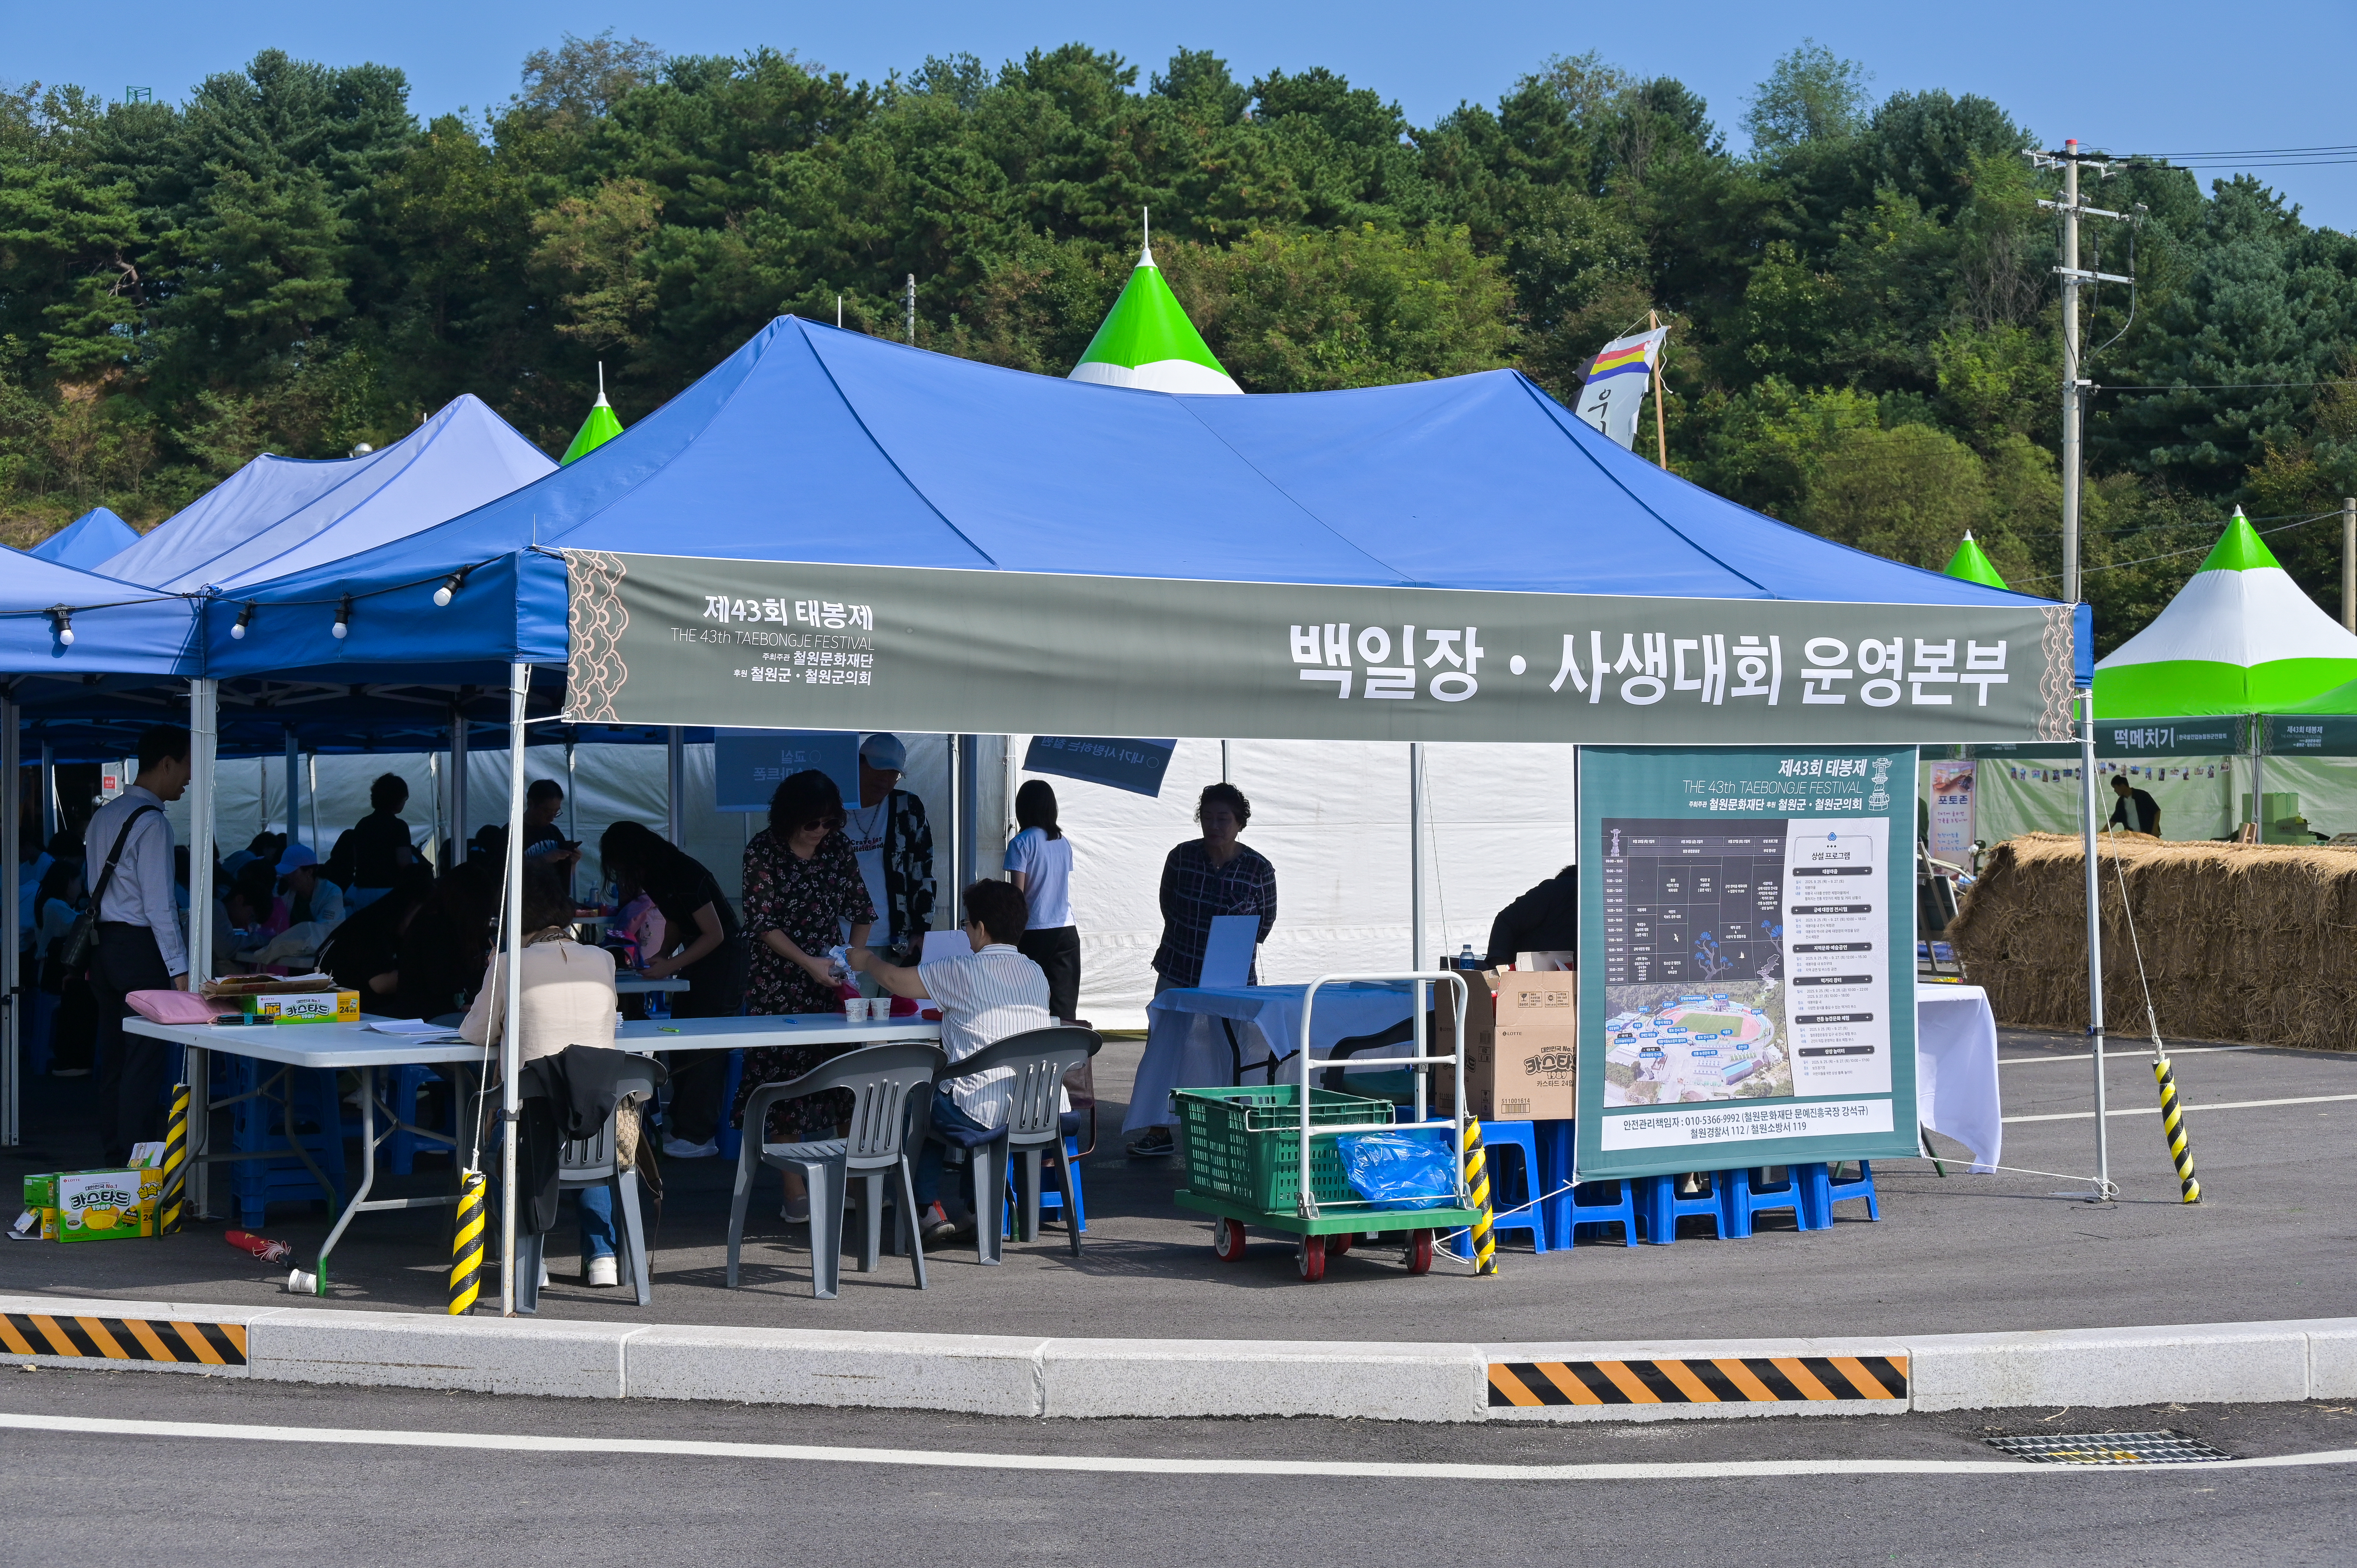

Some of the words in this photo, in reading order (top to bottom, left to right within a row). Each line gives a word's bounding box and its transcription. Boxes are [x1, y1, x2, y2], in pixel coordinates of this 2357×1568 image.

[703, 595, 788, 626] 제43회
[795, 600, 873, 631] 태봉제
[670, 627, 697, 642] THE
[700, 629, 731, 644] 43th
[735, 631, 812, 648] TAEBONGJE
[815, 634, 875, 651] FESTIVAL
[762, 653, 790, 661] 주최주관
[793, 650, 874, 668] 철원문화재단
[1290, 623, 1484, 702] 백일장
[1549, 630, 1782, 706] 사생대회
[1800, 636, 2009, 707] 운영본부
[733, 669, 747, 678] 후원
[751, 666, 791, 683] 철원군
[805, 668, 871, 686] 철원군의회
[2114, 727, 2174, 749] 떡메치기
[1778, 759, 1823, 777] 제43회
[1825, 759, 1868, 777] 태봉제
[1682, 780, 1705, 793] THE
[1708, 780, 1736, 794] 43th
[1739, 781, 1807, 794] TAEBONGJE
[1809, 781, 1863, 794] FESTIVAL
[1709, 798, 1765, 811] 철원문화재단
[1778, 798, 1807, 811] 철원군
[1815, 798, 1862, 810] 철원군의회
[1938, 795, 1968, 804] 포토존
[1812, 852, 1824, 860] 상설
[1825, 852, 1850, 860] 프로그램
[286, 1004, 329, 1017] 카스타드
[1623, 1117, 1680, 1131] 안전관리책임자
[1685, 1114, 1740, 1127] 010-5366-9992
[1742, 1111, 1793, 1124] (철원문화재단
[1794, 1107, 1840, 1120] 문예진흥국장
[1841, 1105, 1868, 1117] 강석규)
[1690, 1127, 1729, 1139] 철원경찰서
[1731, 1126, 1745, 1135] 112
[1751, 1123, 1792, 1135] 철원소방서
[1793, 1122, 1807, 1131] 119
[70, 1190, 130, 1209] 카스타드
